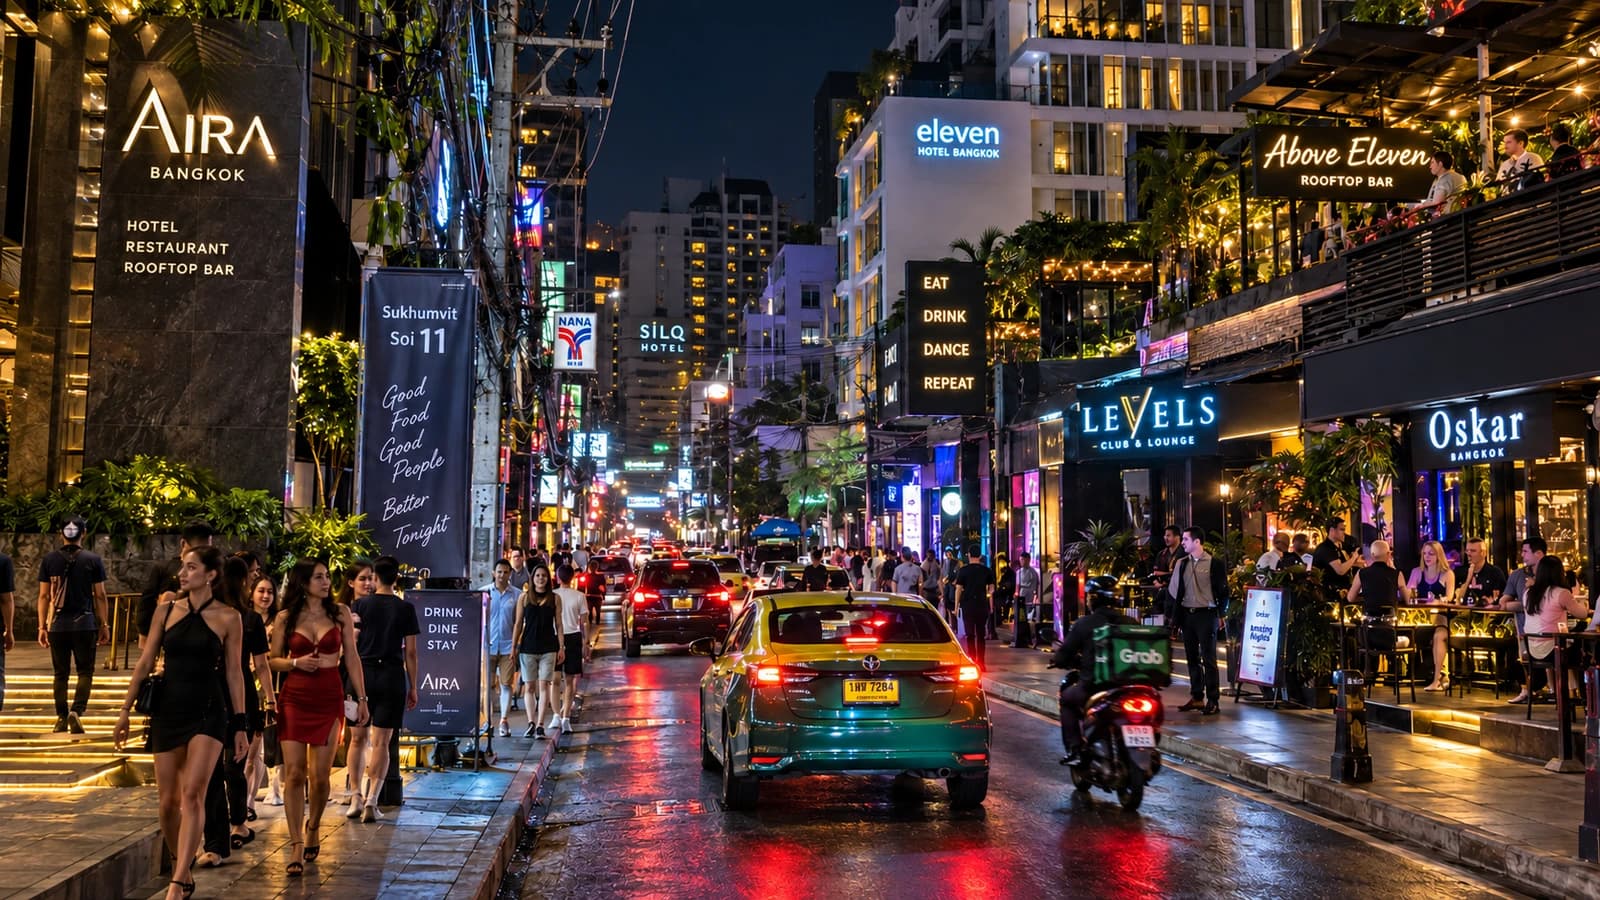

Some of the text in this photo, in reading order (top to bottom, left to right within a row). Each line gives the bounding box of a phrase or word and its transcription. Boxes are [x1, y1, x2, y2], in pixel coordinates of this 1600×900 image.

[123, 87, 275, 157] AIRA
[917, 119, 999, 144] eleven
[918, 147, 999, 158] HOTEL BANGKOK
[1264, 135, 1430, 168] Above Eleven
[151, 167, 244, 181] BANGKOK
[1302, 176, 1392, 186] ROOFTOP BAR
[128, 221, 178, 232] HOTEL
[127, 241, 228, 254] RESTAURANT
[125, 262, 233, 275] ROOFTOP BAR
[925, 277, 948, 288] EAT
[383, 305, 458, 320] Sukhumvit
[925, 310, 965, 322] DRINK
[558, 317, 592, 326] NANA
[391, 328, 444, 353] Soi 11
[641, 344, 683, 352] HOTEL
[925, 344, 968, 355] DANCE
[925, 377, 973, 389] REPEAT
[382, 376, 428, 410] Good
[391, 401, 431, 432] Food
[1082, 387, 1216, 440] LEVELS
[1430, 407, 1523, 448] Oskar
[379, 428, 425, 464] Good
[1101, 440, 1129, 449] CLUB
[1148, 436, 1194, 446] LOUNGE
[1451, 448, 1504, 461] BANGKOK
[391, 447, 445, 483] People
[383, 494, 429, 521] Better
[393, 515, 451, 548] Tonight
[425, 608, 462, 617] DRINK
[429, 624, 458, 634] DINE
[428, 640, 457, 650] STAY
[1120, 648, 1164, 665] Grab
[421, 673, 460, 690] AIRA
[870, 682, 894, 692] 7284
